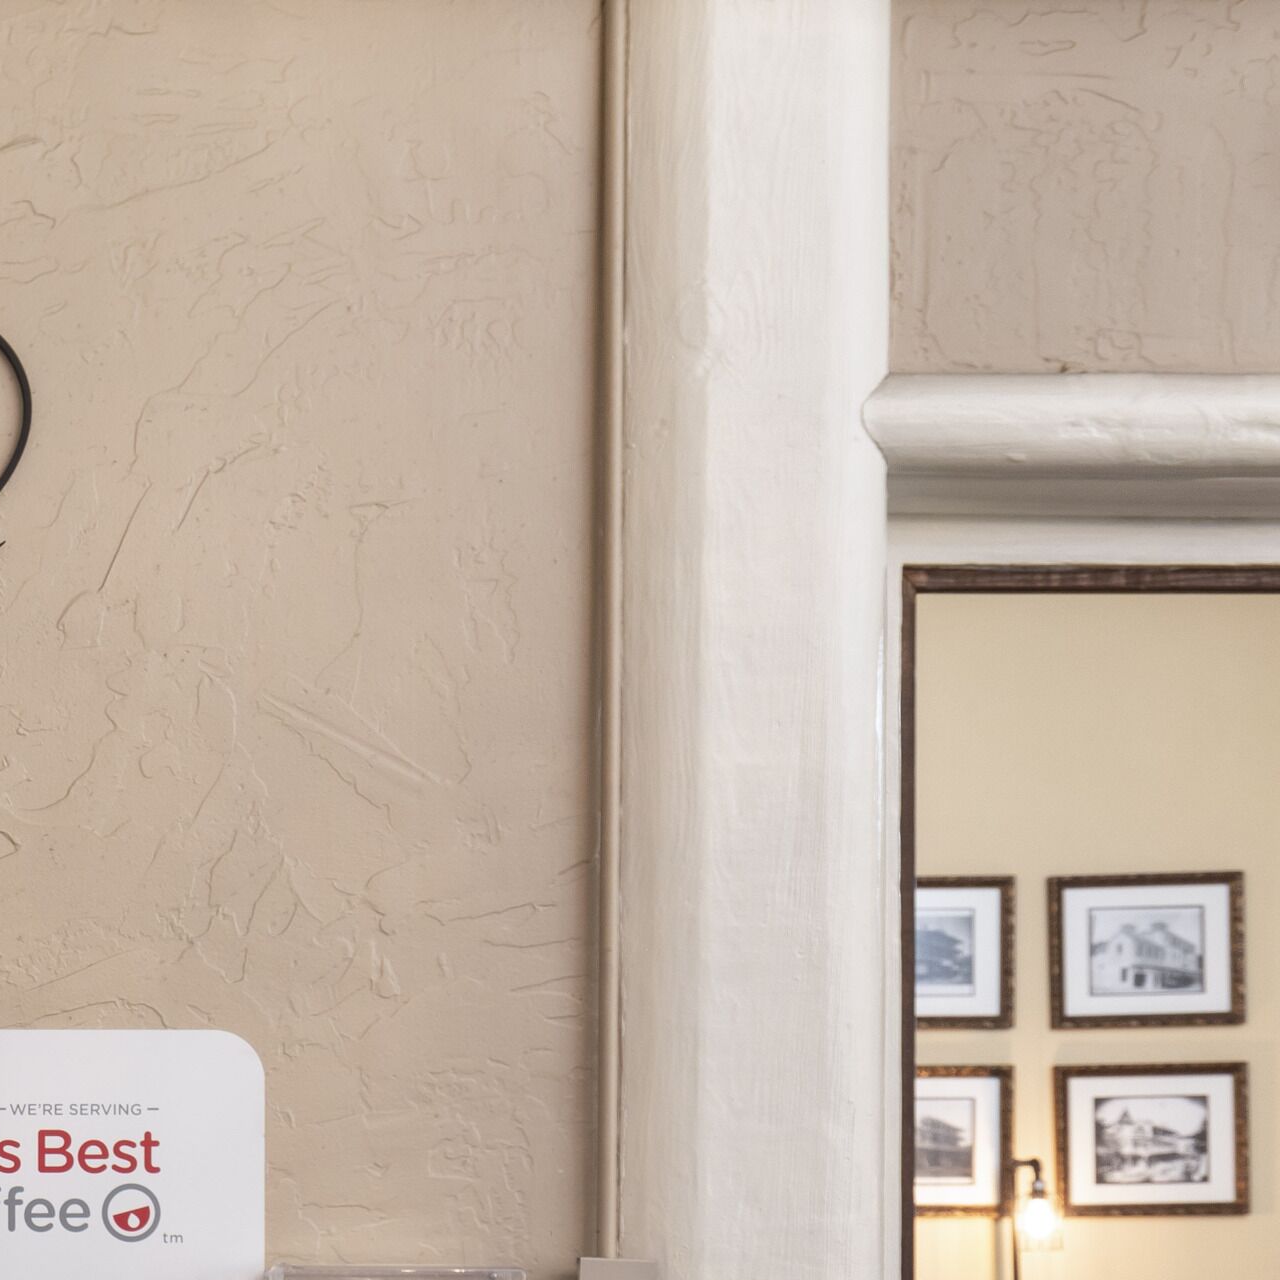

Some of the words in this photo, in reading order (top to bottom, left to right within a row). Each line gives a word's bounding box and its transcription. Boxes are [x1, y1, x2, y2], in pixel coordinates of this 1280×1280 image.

[10, 1104, 63, 1116] WE'RE
[69, 1104, 142, 1116] SERVING
[38, 1129, 161, 1174] Best
[163, 1233, 184, 1244] tm
